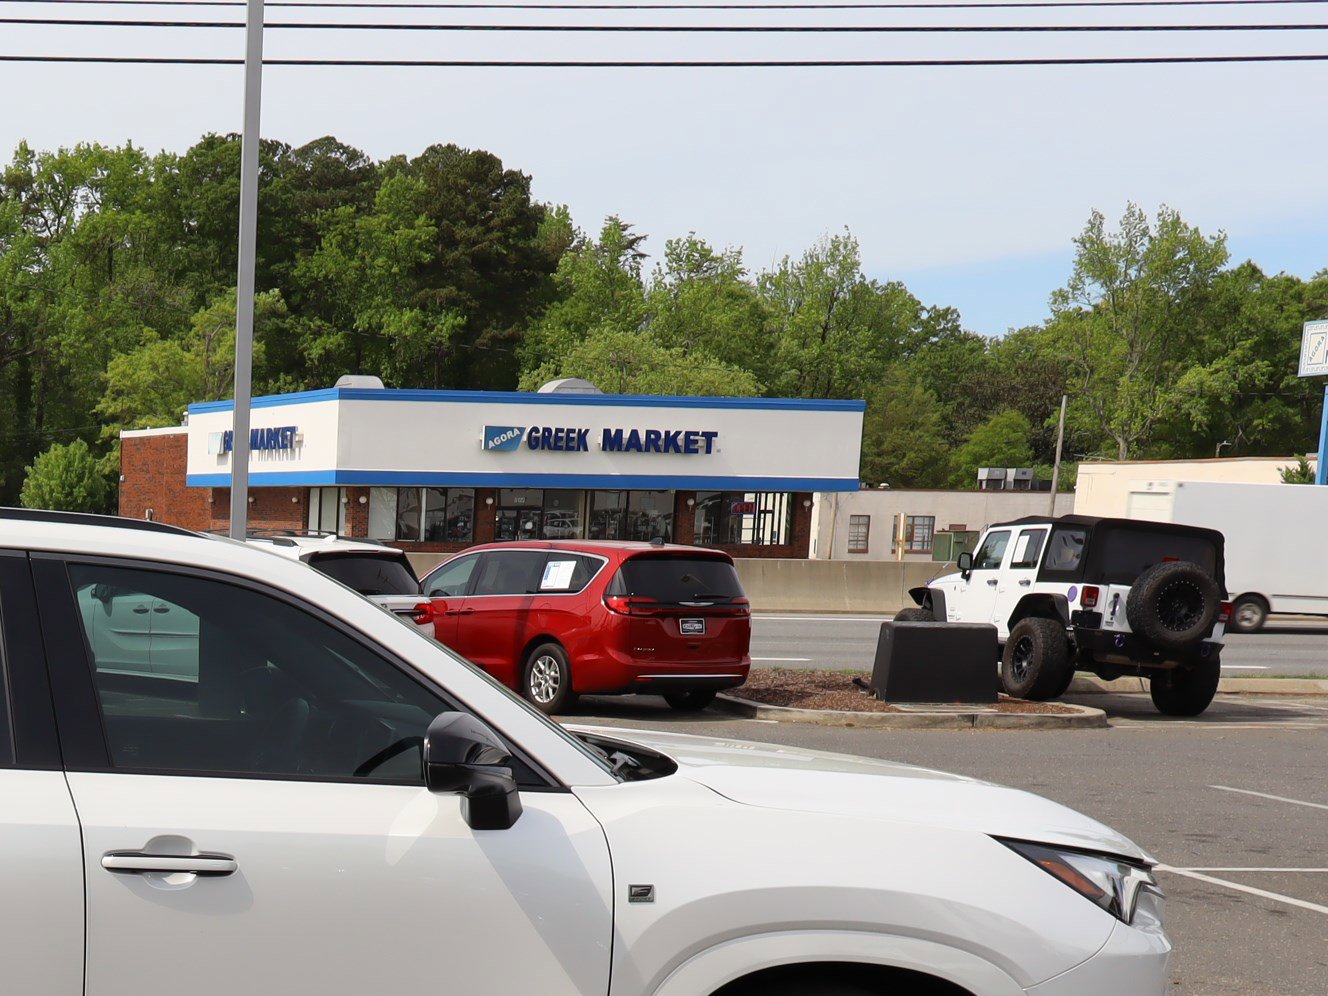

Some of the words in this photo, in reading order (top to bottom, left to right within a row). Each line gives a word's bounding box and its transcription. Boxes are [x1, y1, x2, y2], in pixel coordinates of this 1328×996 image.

[1309, 336, 1325, 362] AGORA
[249, 426, 298, 450] MARKET
[488, 428, 521, 449] AGORA
[527, 426, 590, 452] GREEK
[601, 428, 719, 454] MARKET
